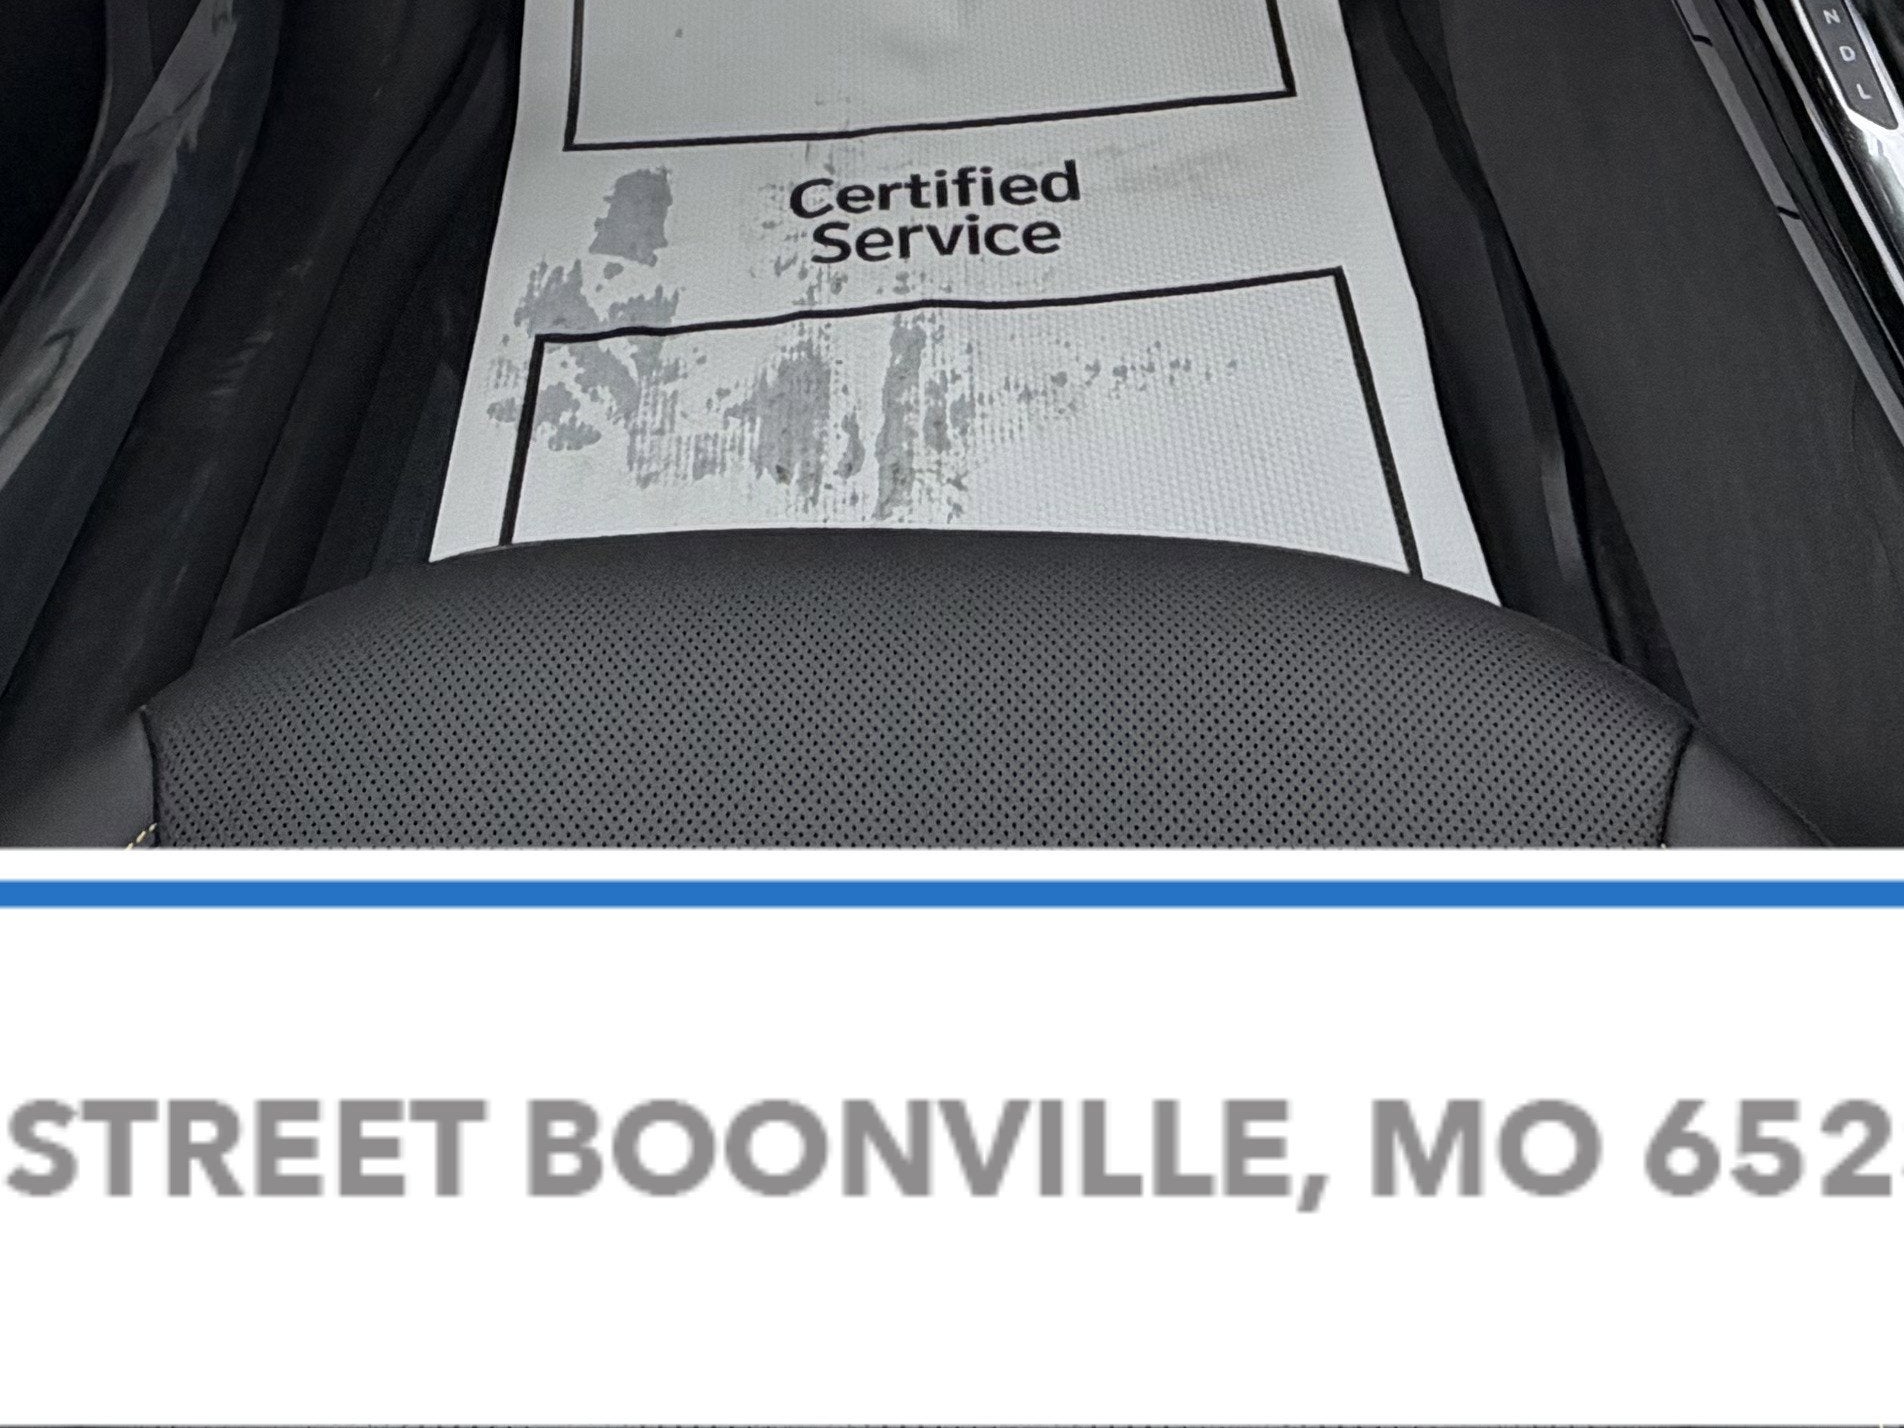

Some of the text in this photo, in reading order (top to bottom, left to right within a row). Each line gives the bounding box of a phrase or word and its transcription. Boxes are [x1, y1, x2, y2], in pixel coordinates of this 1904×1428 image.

[1823, 9, 1841, 25] N
[1839, 46, 1856, 63] D
[1858, 85, 1873, 101] L
[790, 159, 1081, 219] Certified
[811, 214, 1061, 264] Service
